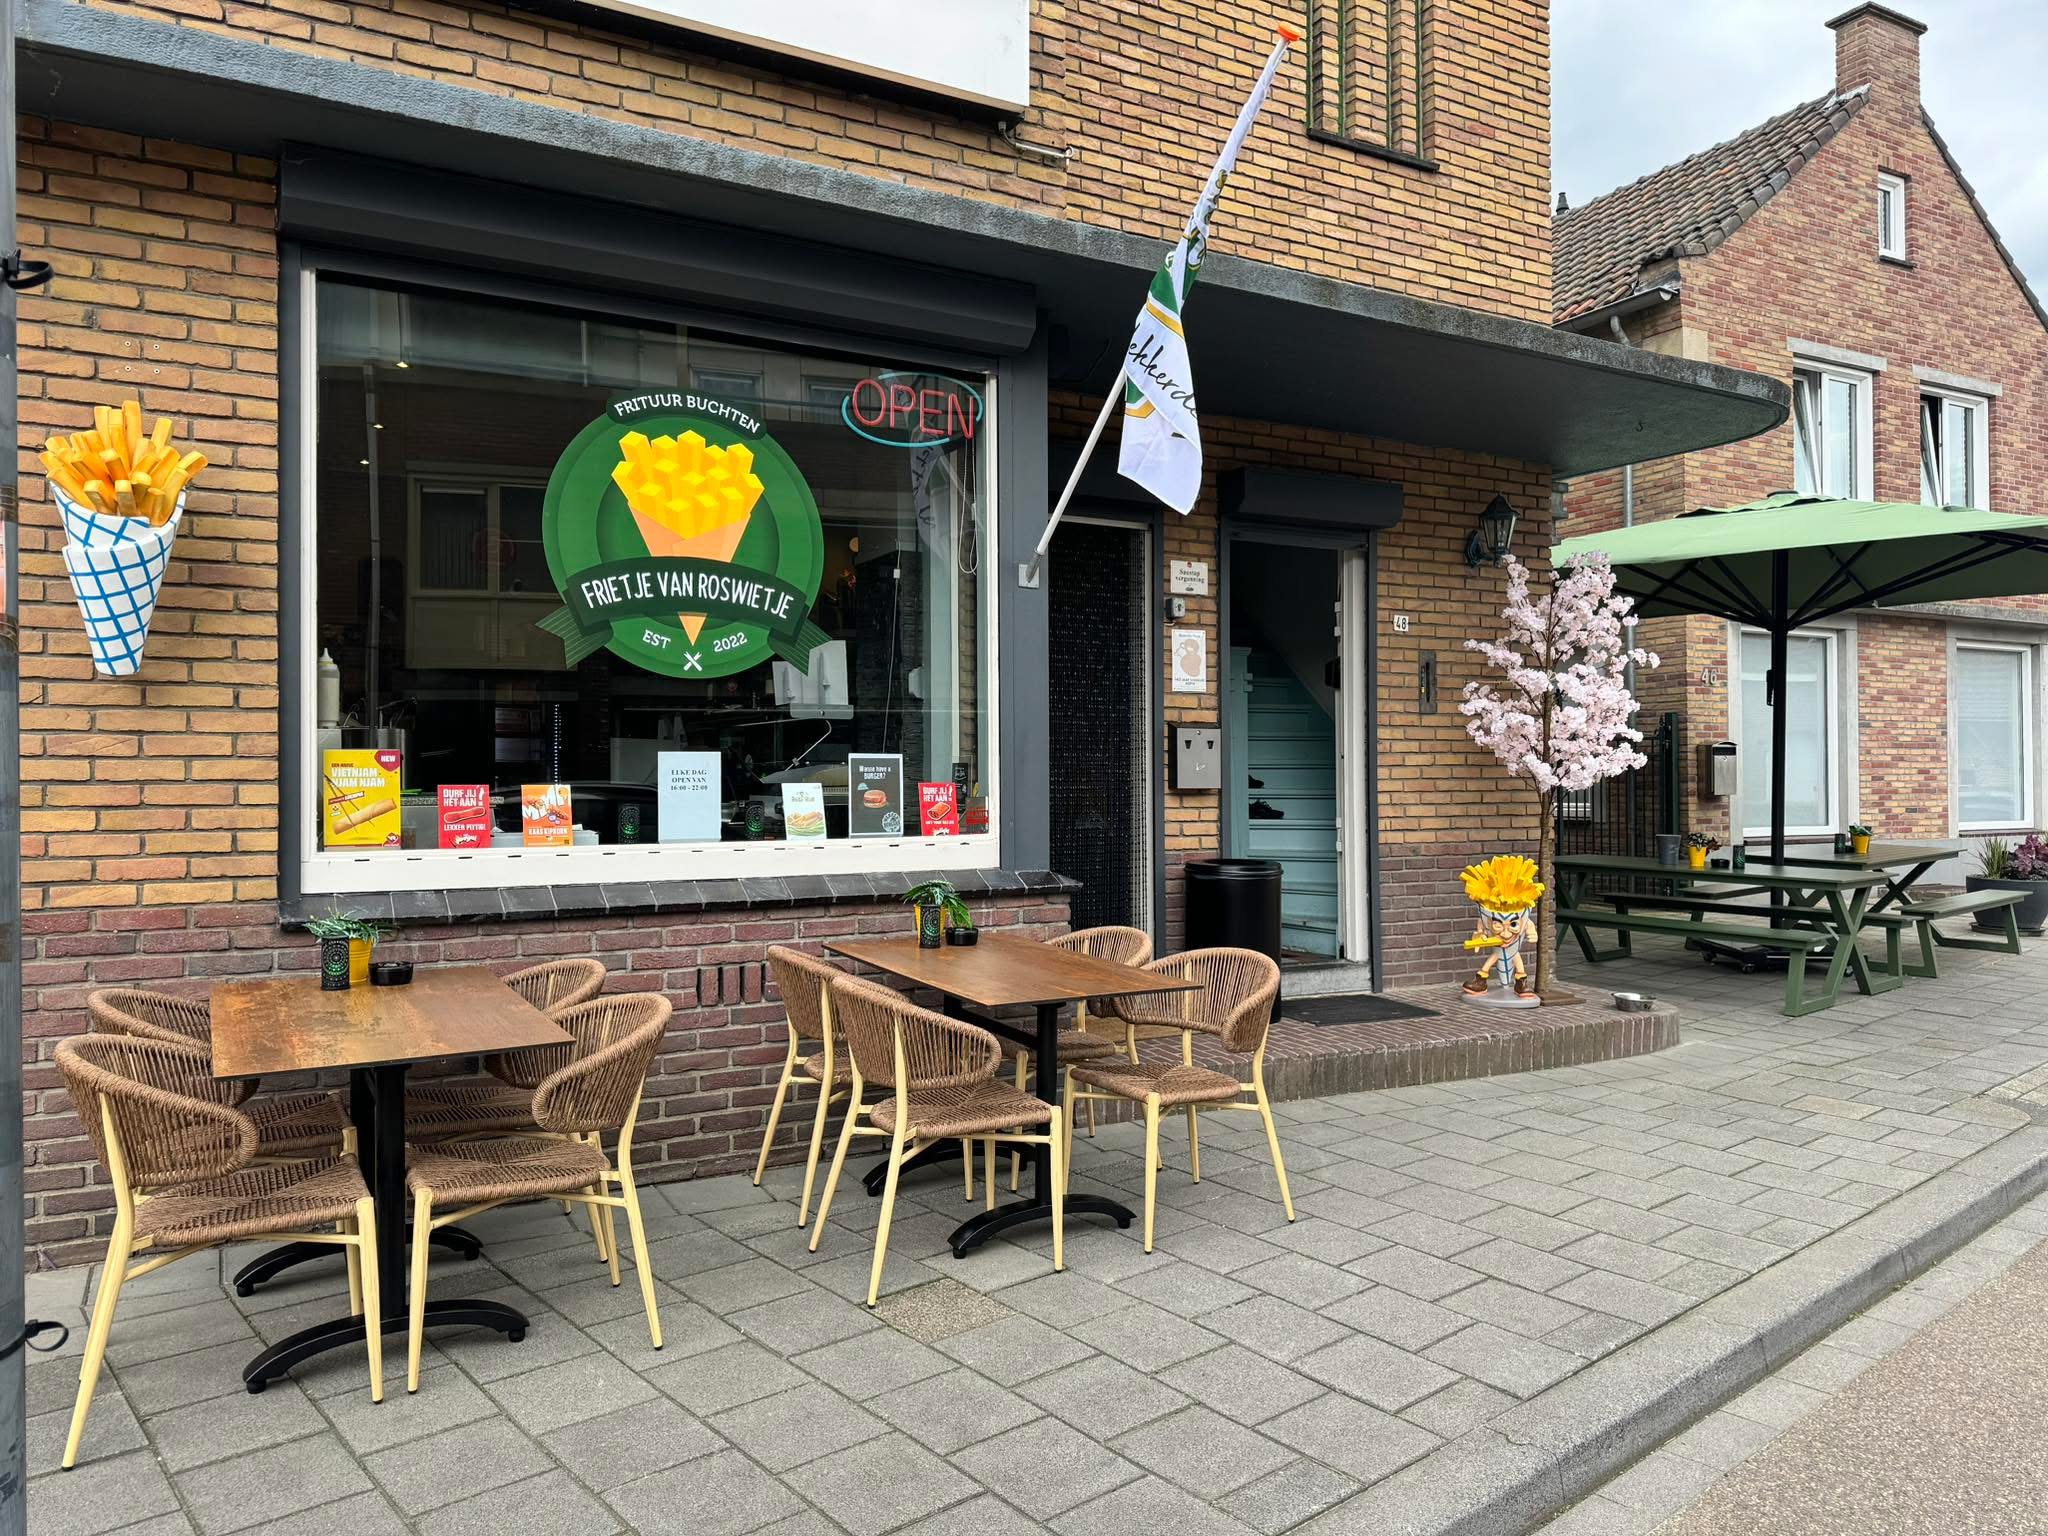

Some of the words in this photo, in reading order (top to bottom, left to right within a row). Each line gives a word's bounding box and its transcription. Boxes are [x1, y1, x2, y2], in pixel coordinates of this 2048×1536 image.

[614, 393, 683, 416] FRITUUR
[686, 394, 760, 433] BUCHTEN
[852, 378, 975, 440] OPEN
[581, 572, 652, 608] FRIETJE
[656, 571, 694, 597] VAN
[698, 575, 794, 619] ROSWIETJE
[1396, 616, 1406, 630] 48
[642, 629, 671, 649] EST
[713, 632, 748, 653] 2022
[1701, 667, 1717, 685] 46
[380, 755, 397, 763] NEW
[331, 767, 378, 778] VIETNJAM
[360, 777, 385, 788] NJAM
[443, 789, 464, 798] DURF
[465, 789, 477, 798] JIJ
[443, 797, 458, 807] HET
